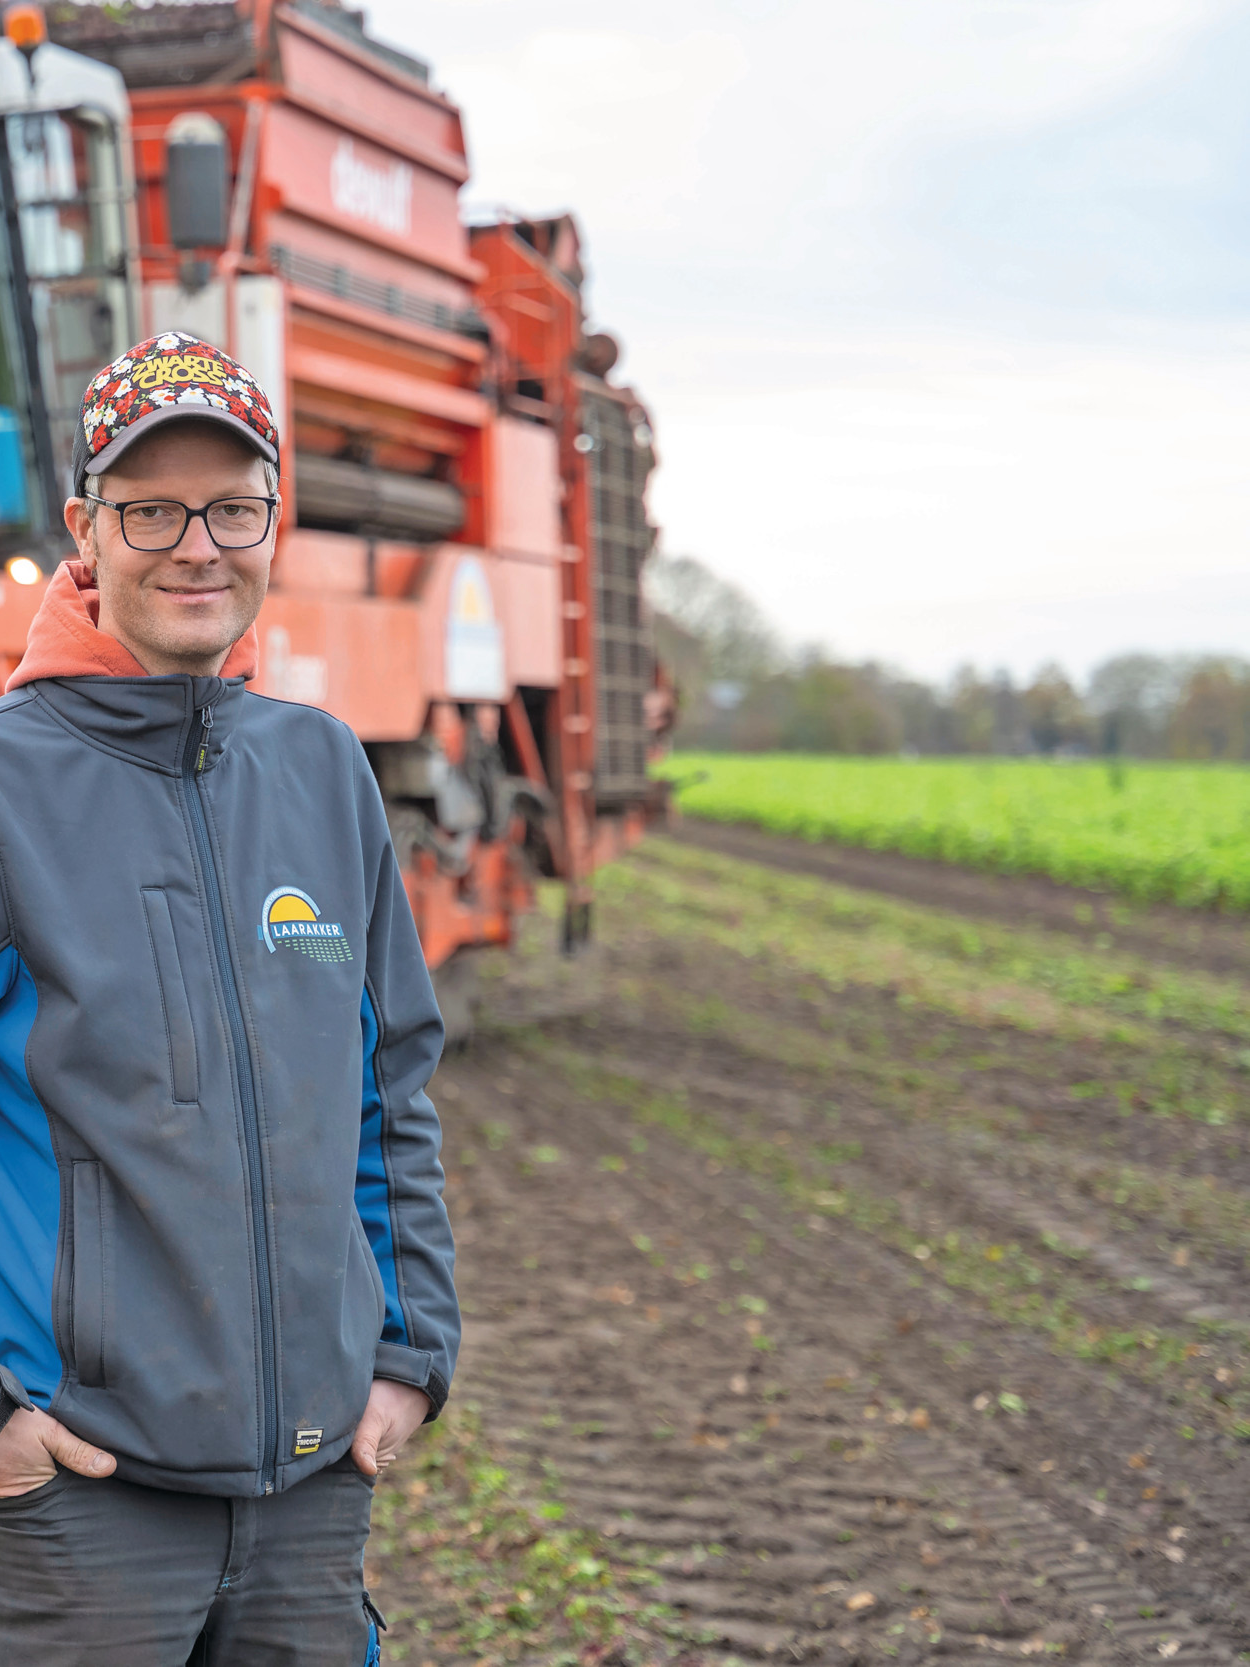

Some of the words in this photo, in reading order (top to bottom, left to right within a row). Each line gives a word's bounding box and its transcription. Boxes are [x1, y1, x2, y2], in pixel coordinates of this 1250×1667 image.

[132, 355, 227, 383] ZWARTE
[139, 366, 224, 389] CROSS
[273, 923, 340, 937] LAARAKKER
